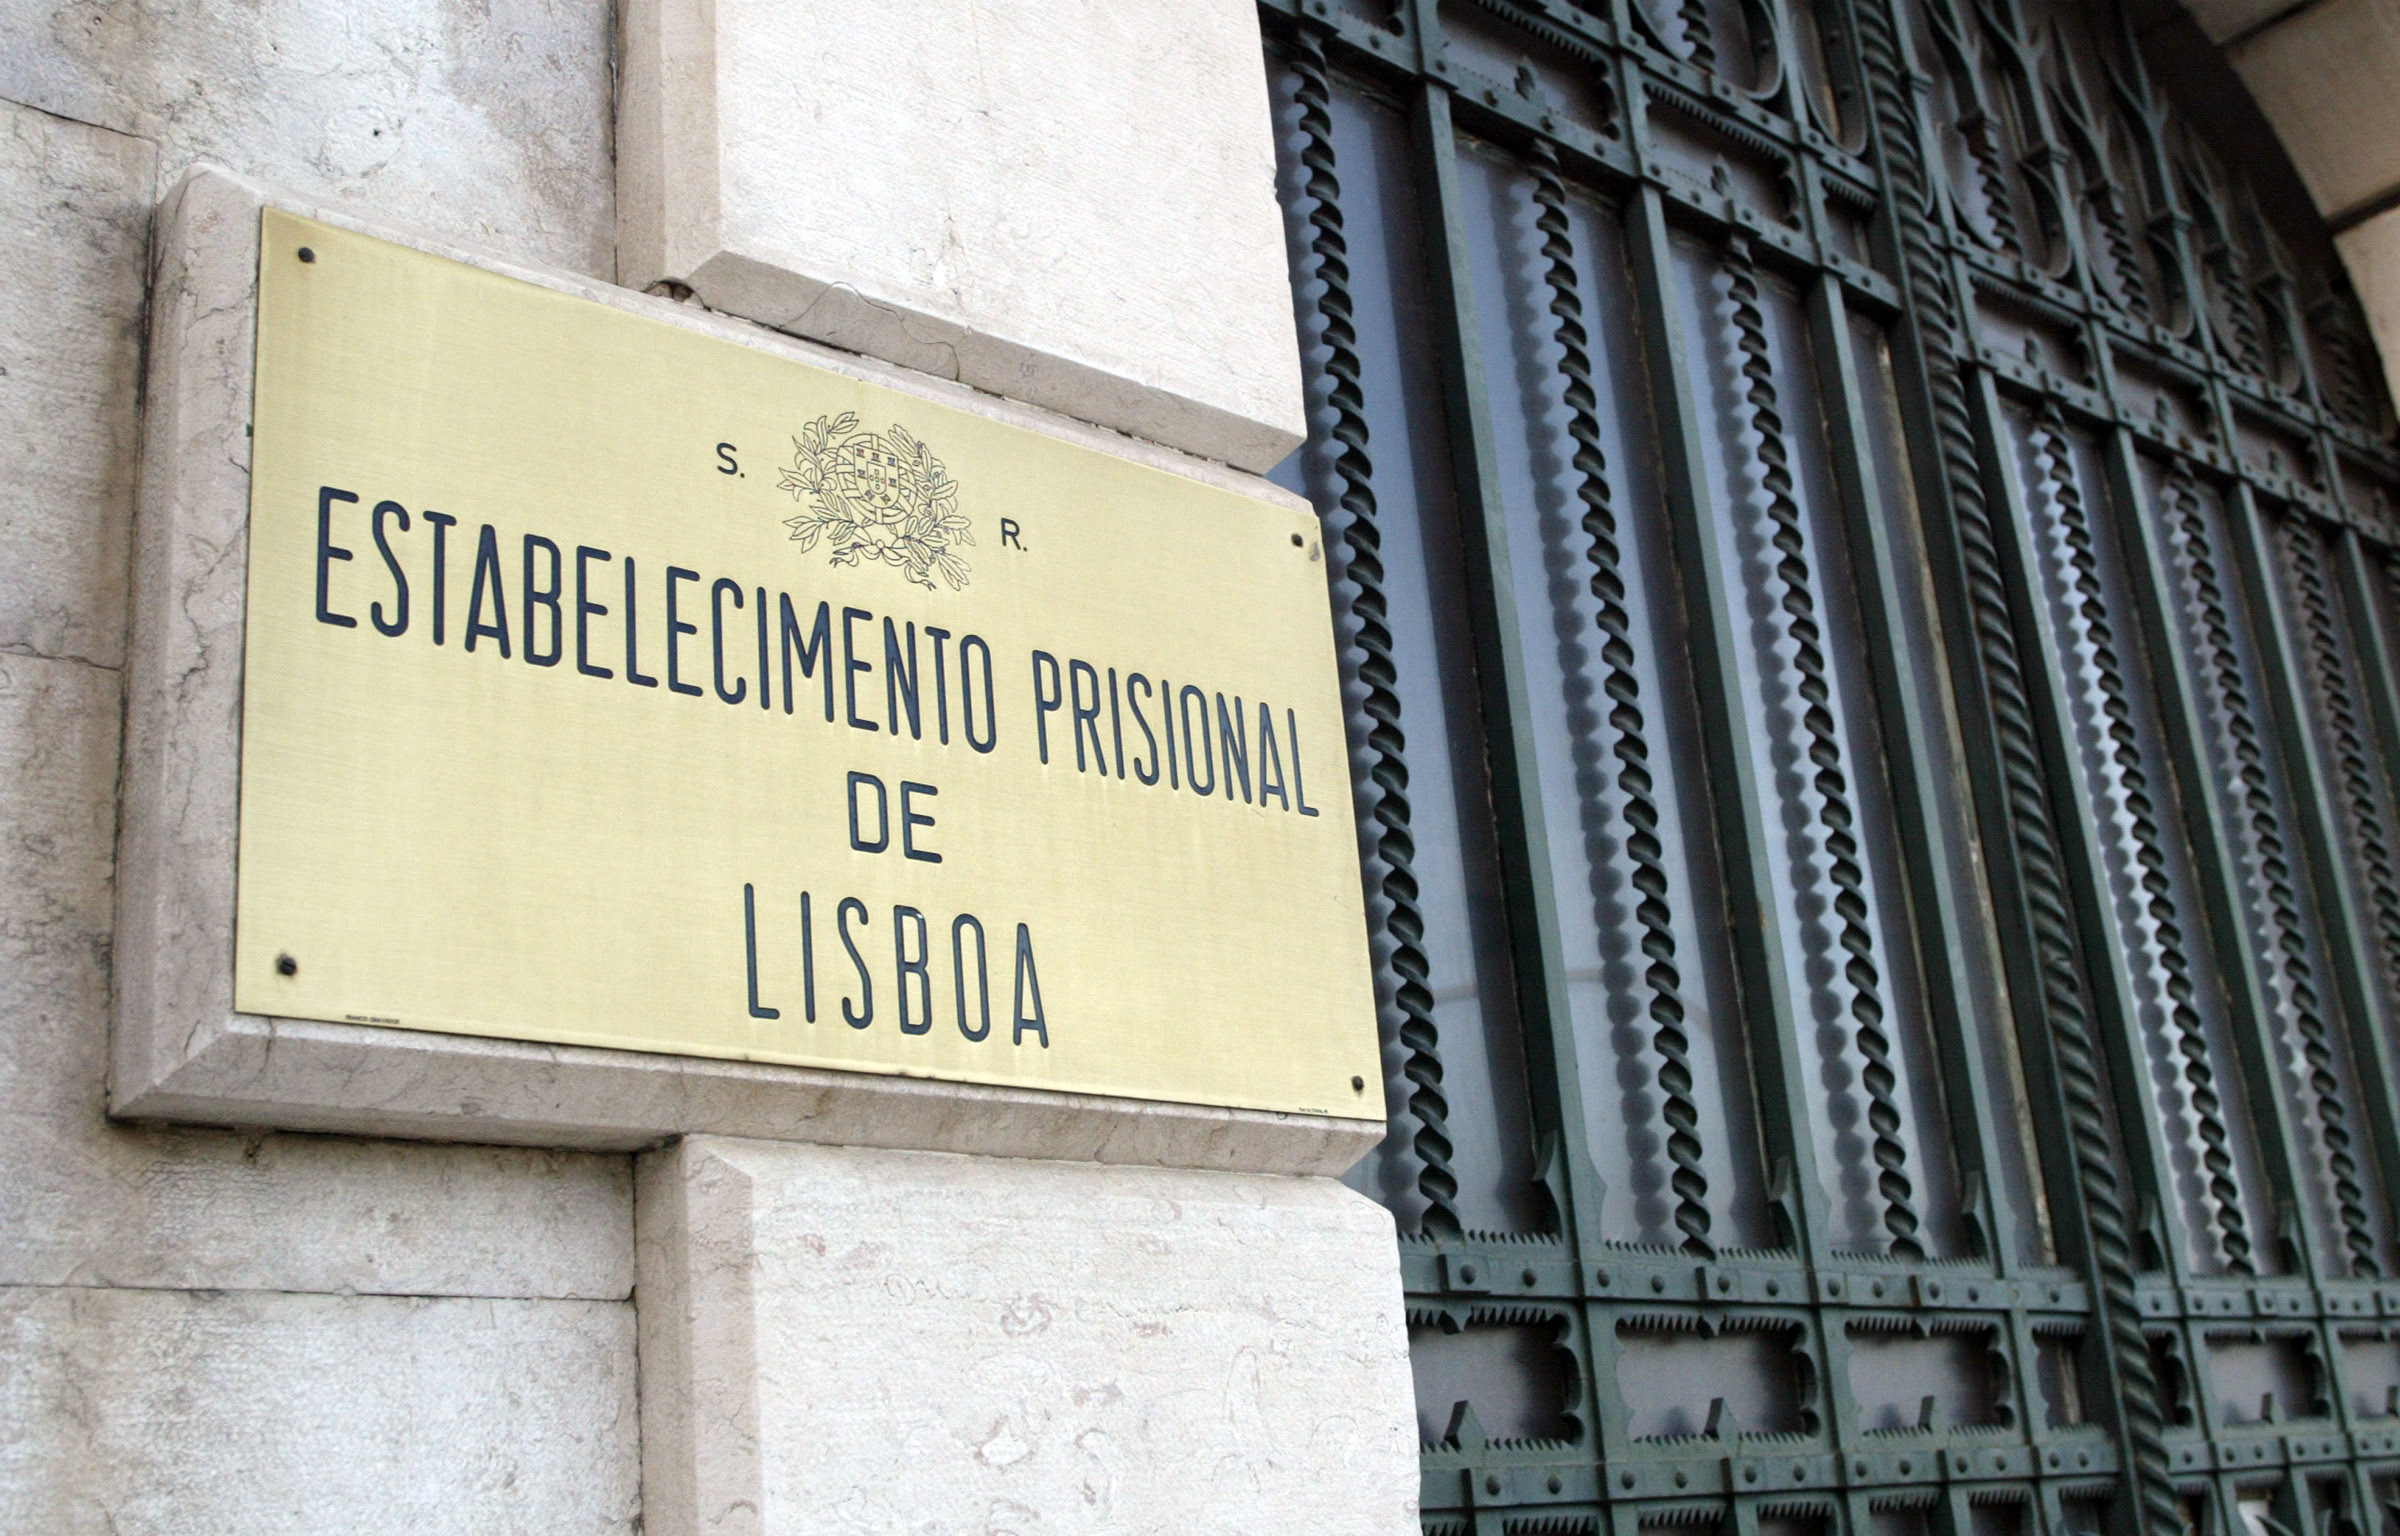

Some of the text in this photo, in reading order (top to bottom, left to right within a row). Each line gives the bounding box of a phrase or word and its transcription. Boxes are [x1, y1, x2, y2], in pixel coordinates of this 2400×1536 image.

[715, 441, 1029, 553] S. R.
[315, 485, 1320, 818] ESTABELECIMENTO PRISIONAL
[846, 770, 943, 864] DE
[744, 882, 1050, 1050] LISBOA
